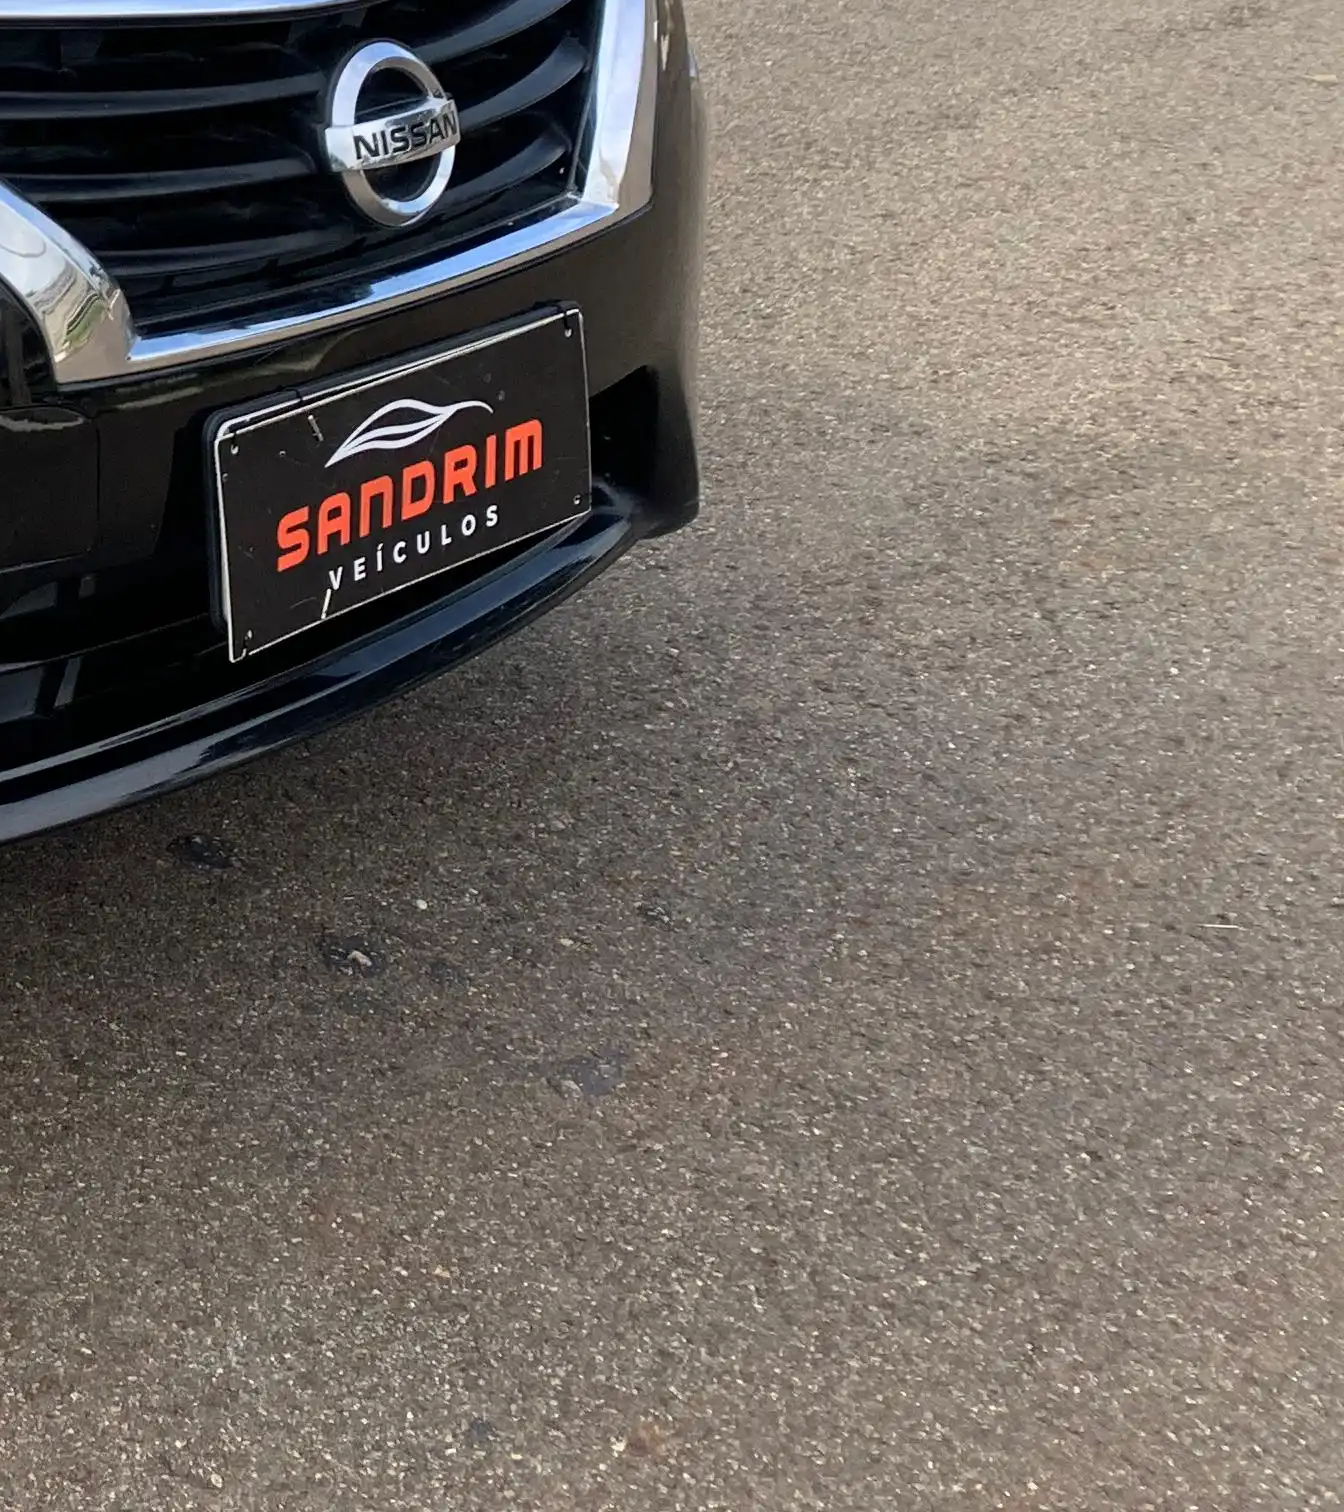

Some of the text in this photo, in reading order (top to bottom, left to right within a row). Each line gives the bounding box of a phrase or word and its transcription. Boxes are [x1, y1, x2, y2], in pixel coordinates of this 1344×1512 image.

[352, 113, 458, 160] NISSAN
[276, 418, 543, 572] SANDRIM
[328, 503, 500, 591] VEÍCULOS
